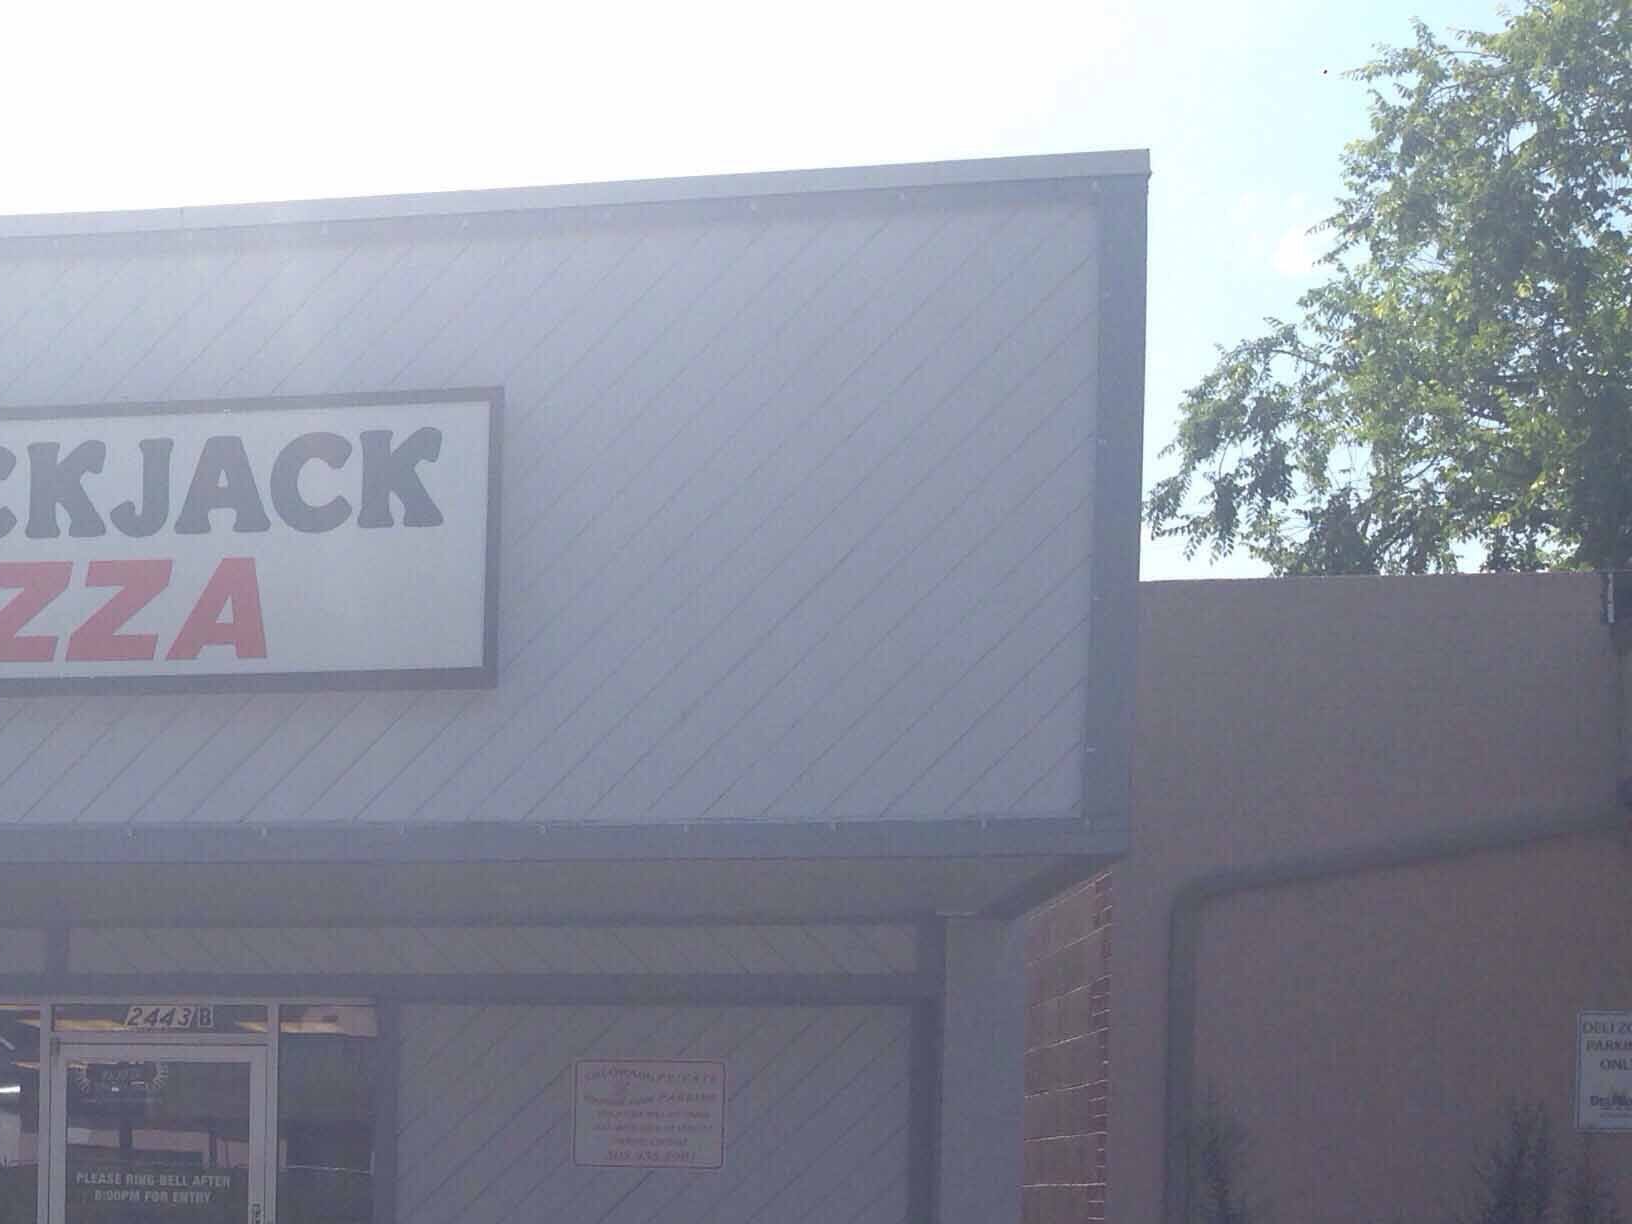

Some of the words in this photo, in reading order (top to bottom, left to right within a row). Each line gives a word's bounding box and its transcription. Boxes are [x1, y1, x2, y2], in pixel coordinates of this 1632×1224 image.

[128, 1006, 192, 1026] 2443
[1584, 1023, 1615, 1034] DELI
[1600, 1058, 1632, 1071] ONL
[75, 1171, 122, 1185] PLEASE
[158, 1174, 188, 1187] BELL
[192, 1176, 232, 1189] AFTER
[144, 1190, 168, 1203] FOR
[172, 1191, 212, 1205] ENTRY
